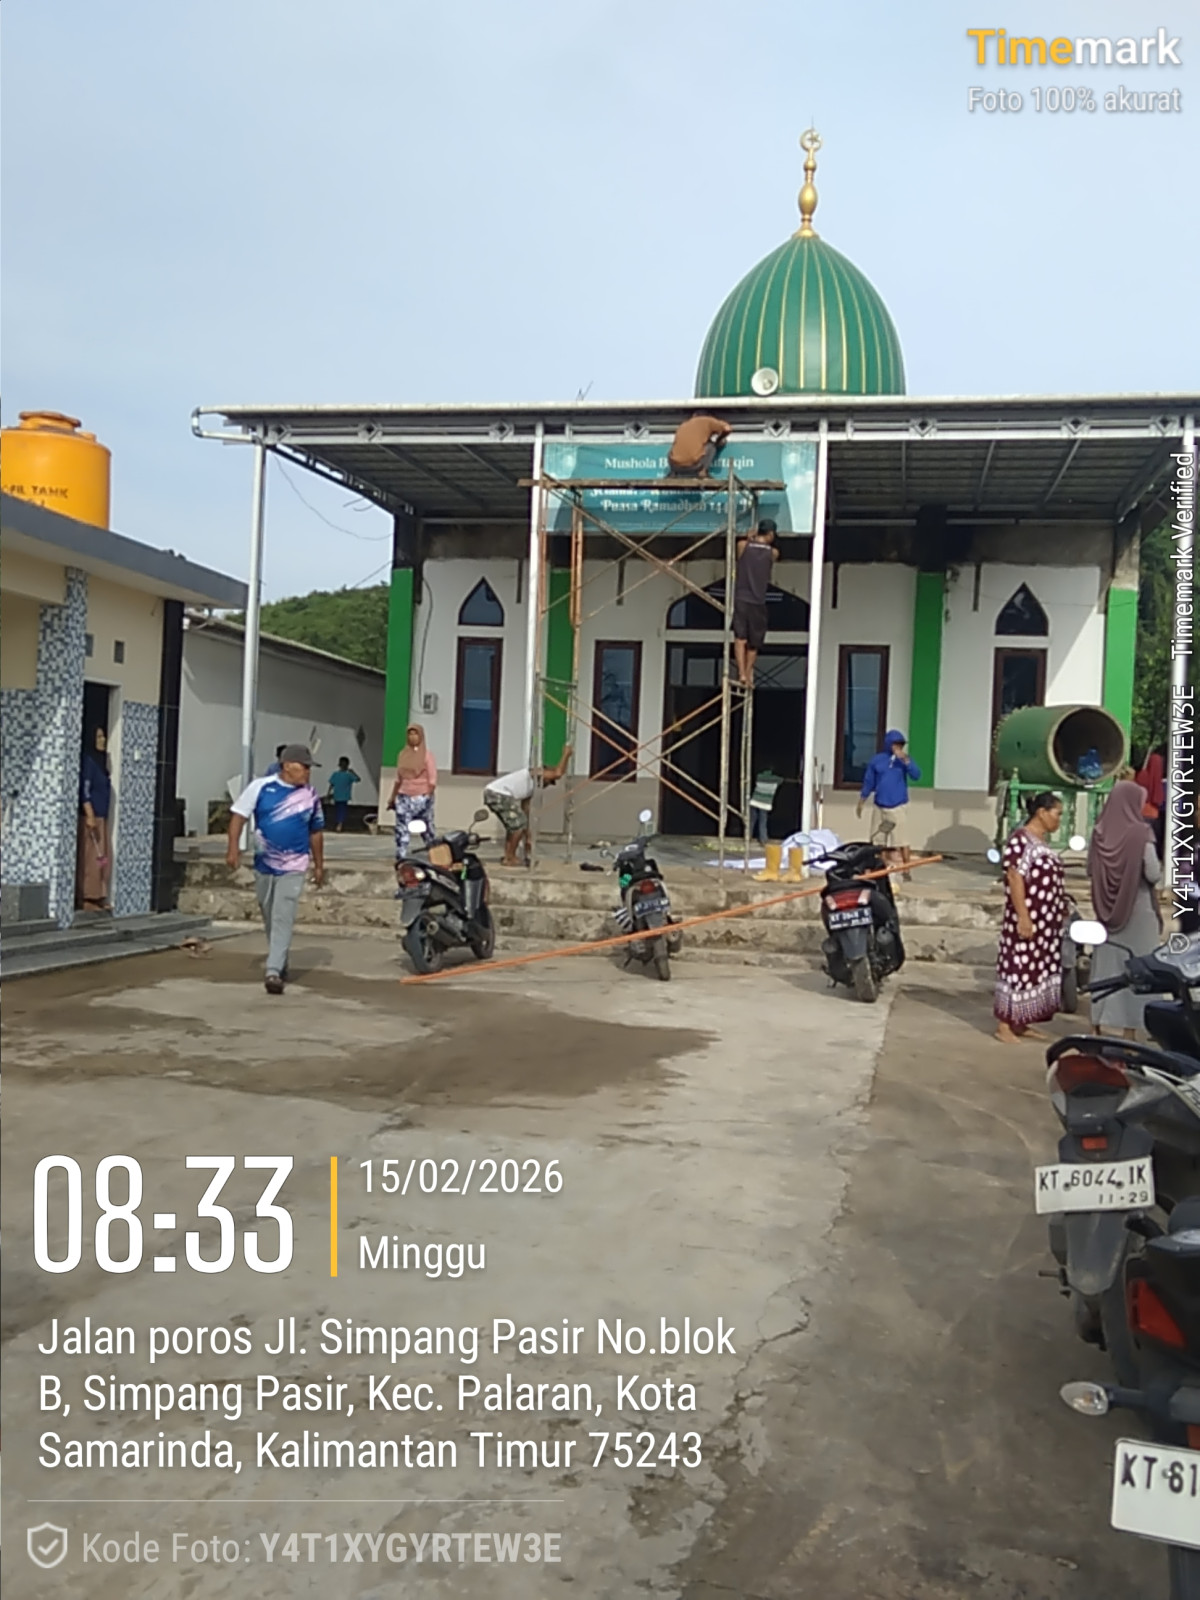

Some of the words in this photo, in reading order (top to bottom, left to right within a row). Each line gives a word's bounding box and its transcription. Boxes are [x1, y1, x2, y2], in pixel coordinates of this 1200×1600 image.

[604, 457, 657, 470] Mushola
[31, 485, 69, 499] TANK
[1039, 1170, 1060, 1191] KT
[1070, 1168, 1118, 1188] 6044
[1121, 1452, 1158, 1490] KT
